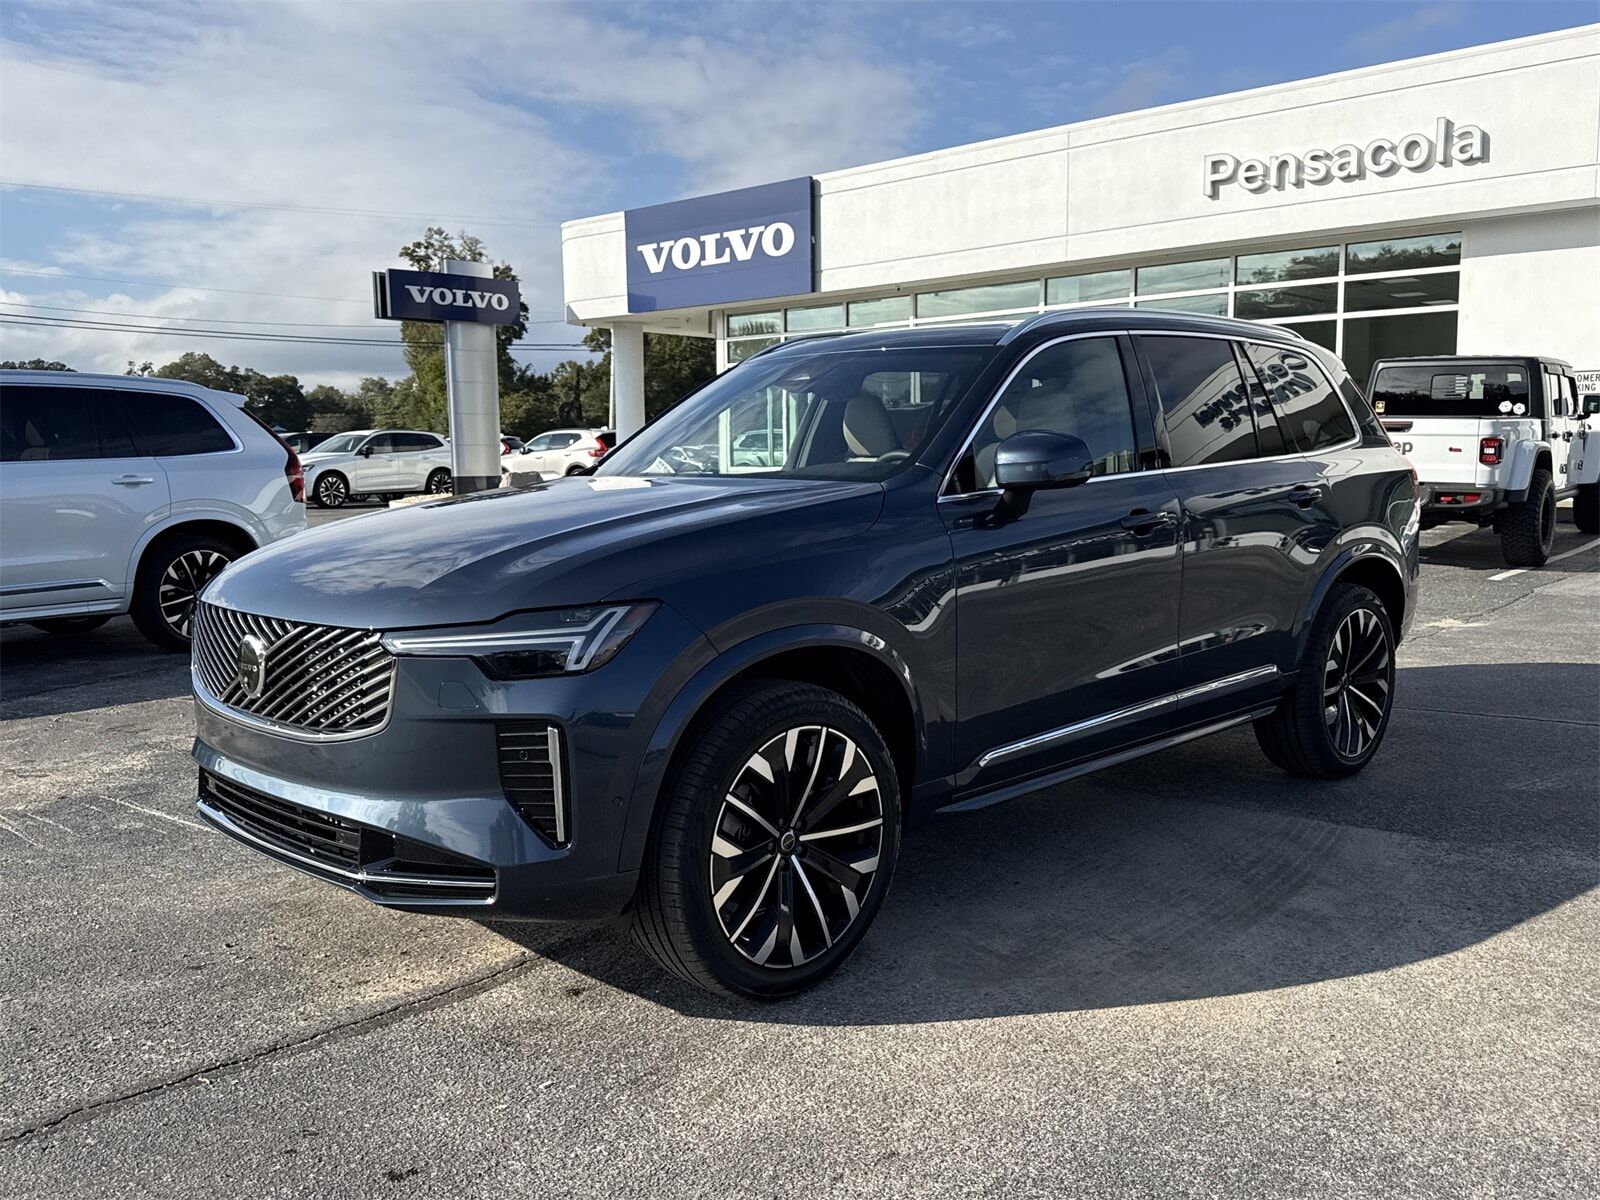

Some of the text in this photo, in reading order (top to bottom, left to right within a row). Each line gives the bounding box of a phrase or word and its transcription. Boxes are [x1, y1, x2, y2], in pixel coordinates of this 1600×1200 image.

[1202, 116, 1490, 200] Pensacola
[637, 221, 795, 274] VOLVO
[404, 285, 509, 311] VOLVO
[1576, 373, 1600, 383] OMER
[1577, 383, 1596, 391] KING
[1393, 441, 1413, 455] ep
